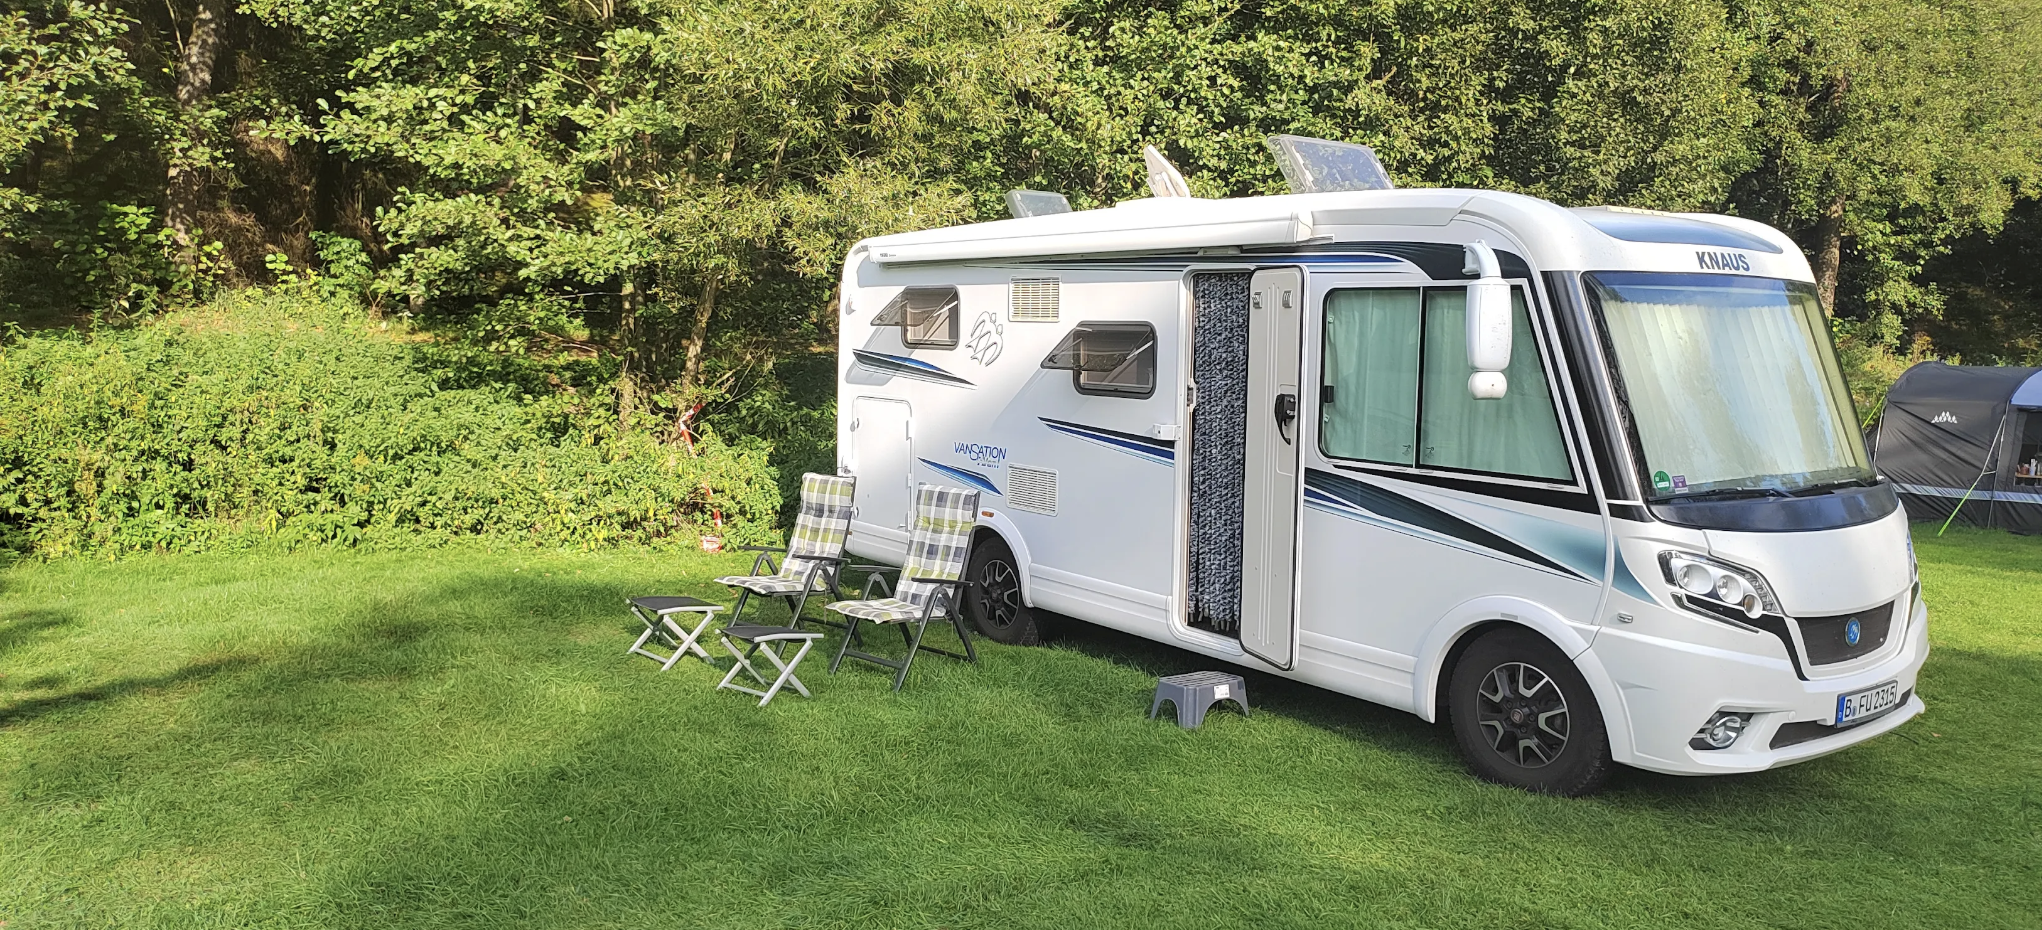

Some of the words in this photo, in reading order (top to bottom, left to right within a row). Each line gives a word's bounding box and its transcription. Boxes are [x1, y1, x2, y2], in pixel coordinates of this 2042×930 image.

[1695, 251, 1750, 272] KNAUS
[954, 441, 1007, 463] VANSATION
[1844, 698, 1853, 718] B
[1858, 692, 1873, 715] FU
[1873, 685, 1896, 710] 2315
